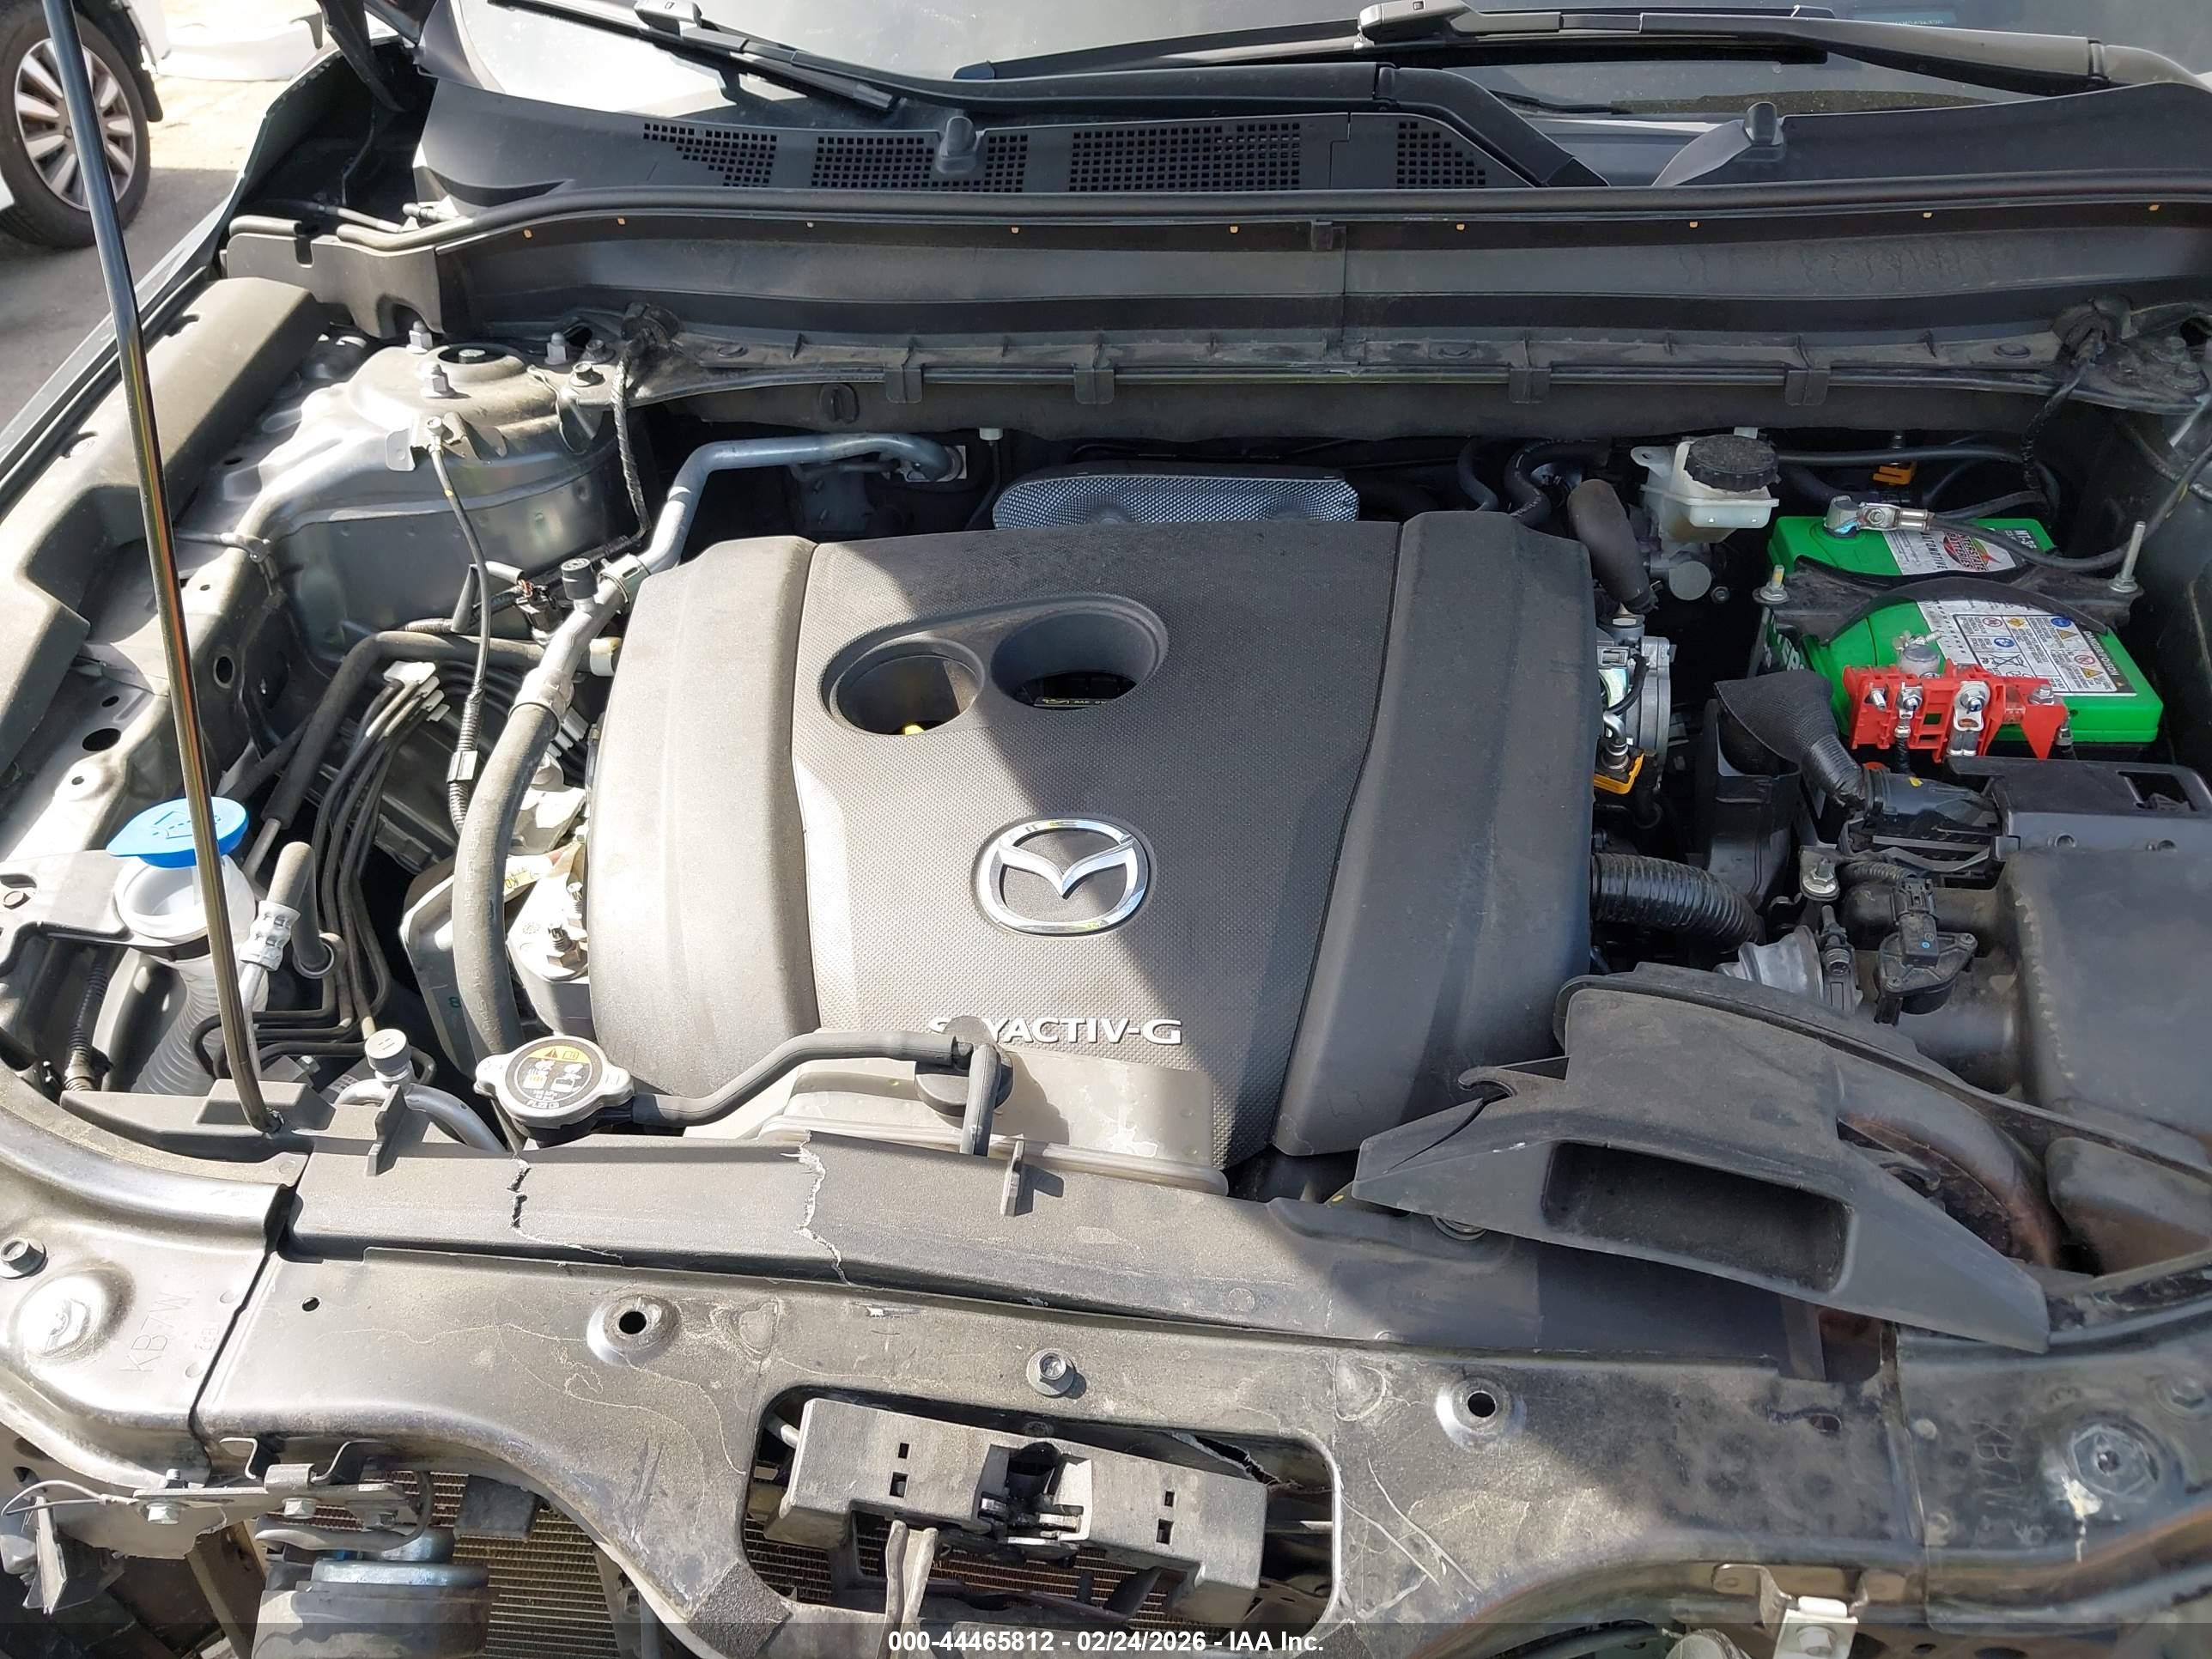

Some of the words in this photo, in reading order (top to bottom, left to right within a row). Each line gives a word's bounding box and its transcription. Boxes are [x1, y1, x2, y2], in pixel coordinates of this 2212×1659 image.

[1920, 532, 1948, 569] AUTOMOTIVE
[1947, 532, 1972, 568] BATTERIES
[2082, 630, 2120, 676] DANGER/POISON
